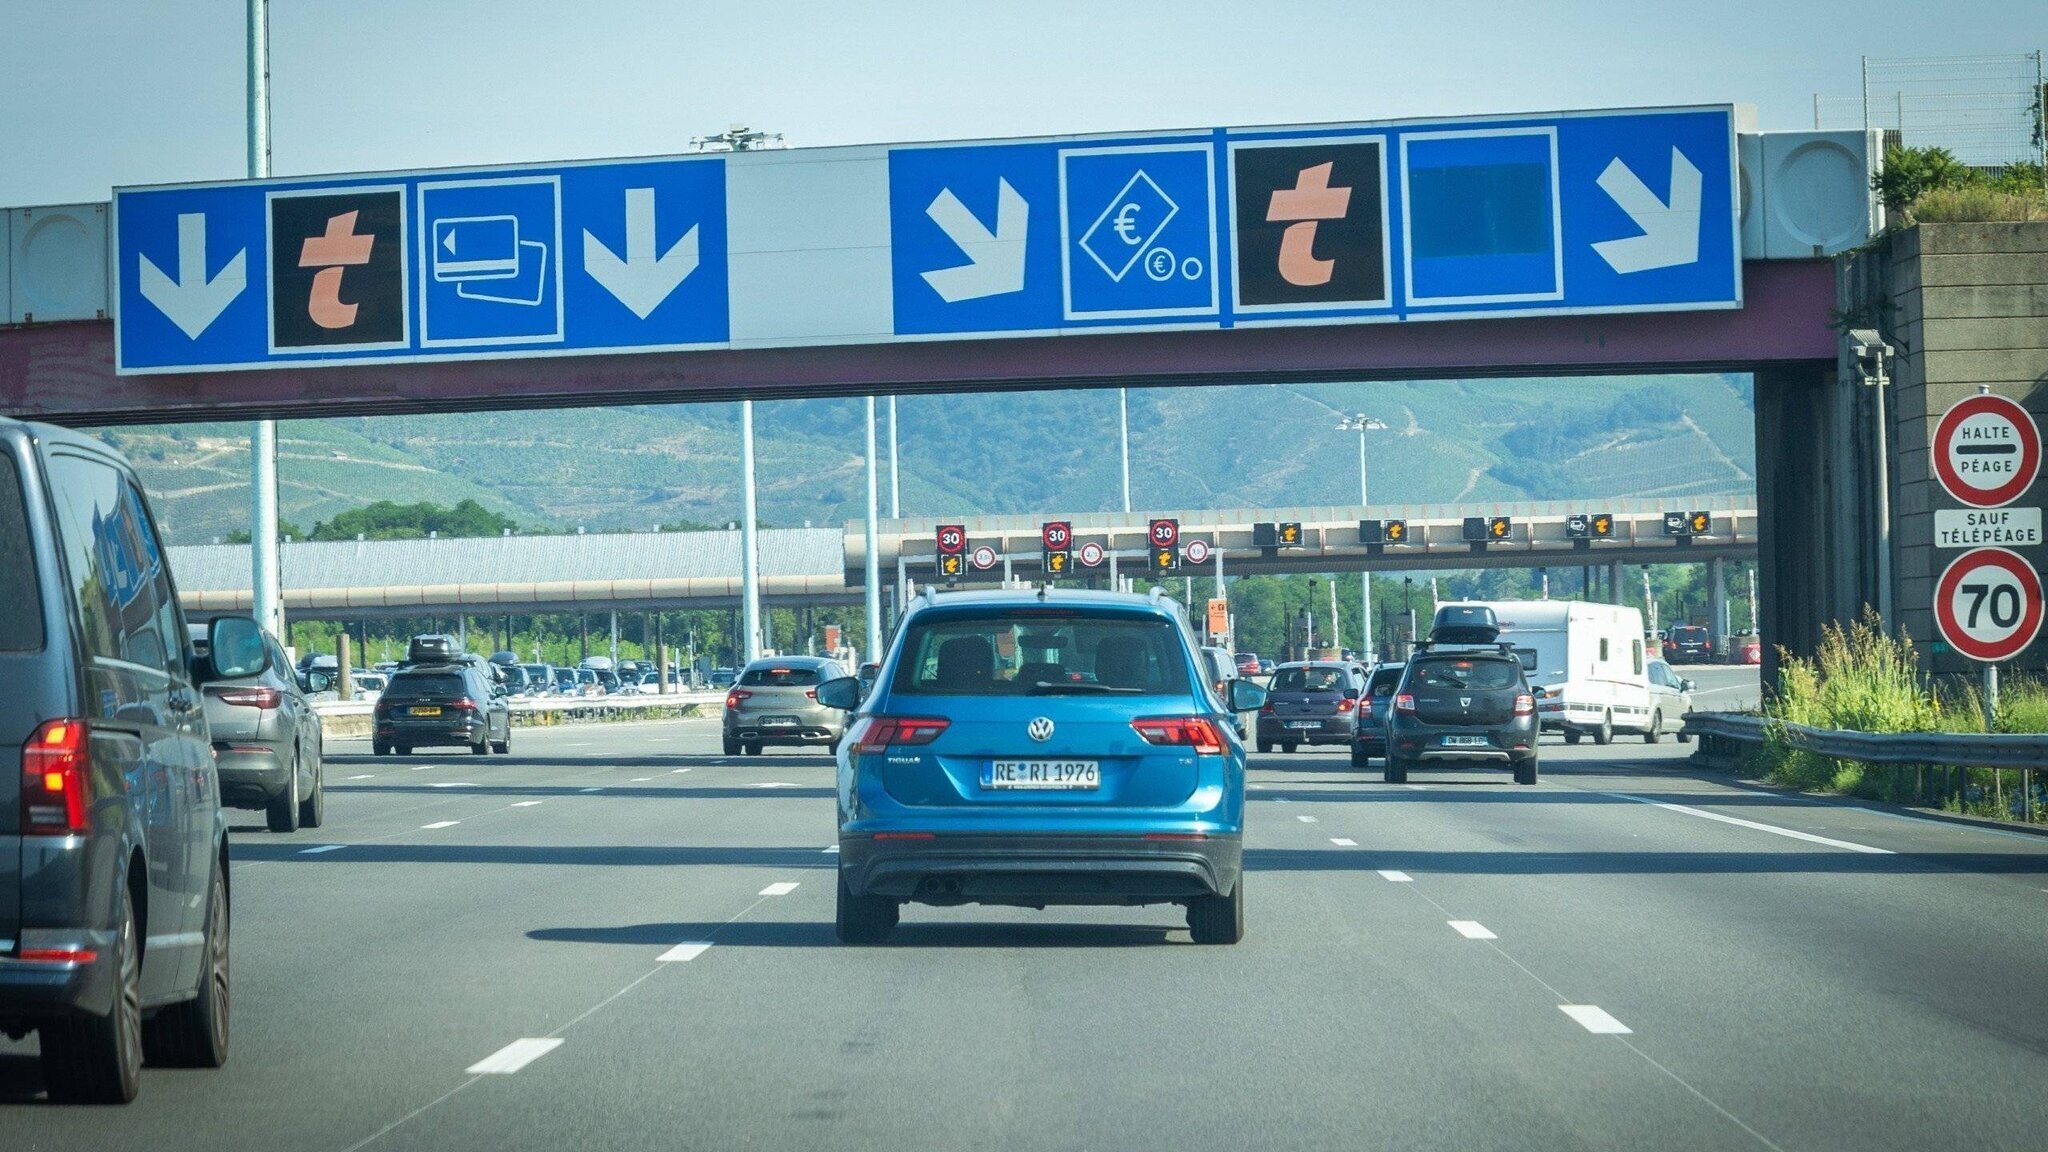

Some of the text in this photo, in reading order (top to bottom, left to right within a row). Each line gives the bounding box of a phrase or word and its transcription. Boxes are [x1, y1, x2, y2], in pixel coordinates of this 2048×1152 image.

[1266, 162, 1351, 286] t
[299, 210, 375, 328] t
[1962, 427, 2009, 440] HALTE
[1962, 459, 2012, 473] PÉAGE
[1967, 512, 2009, 525] SAUF
[943, 533, 959, 544] 30
[1049, 530, 1065, 541] 30
[1156, 527, 1172, 539] 30
[1942, 528, 2036, 544] TÉLÉPÉAGE
[1962, 584, 2020, 628] 70
[996, 764, 1095, 781] RE RI 1976
